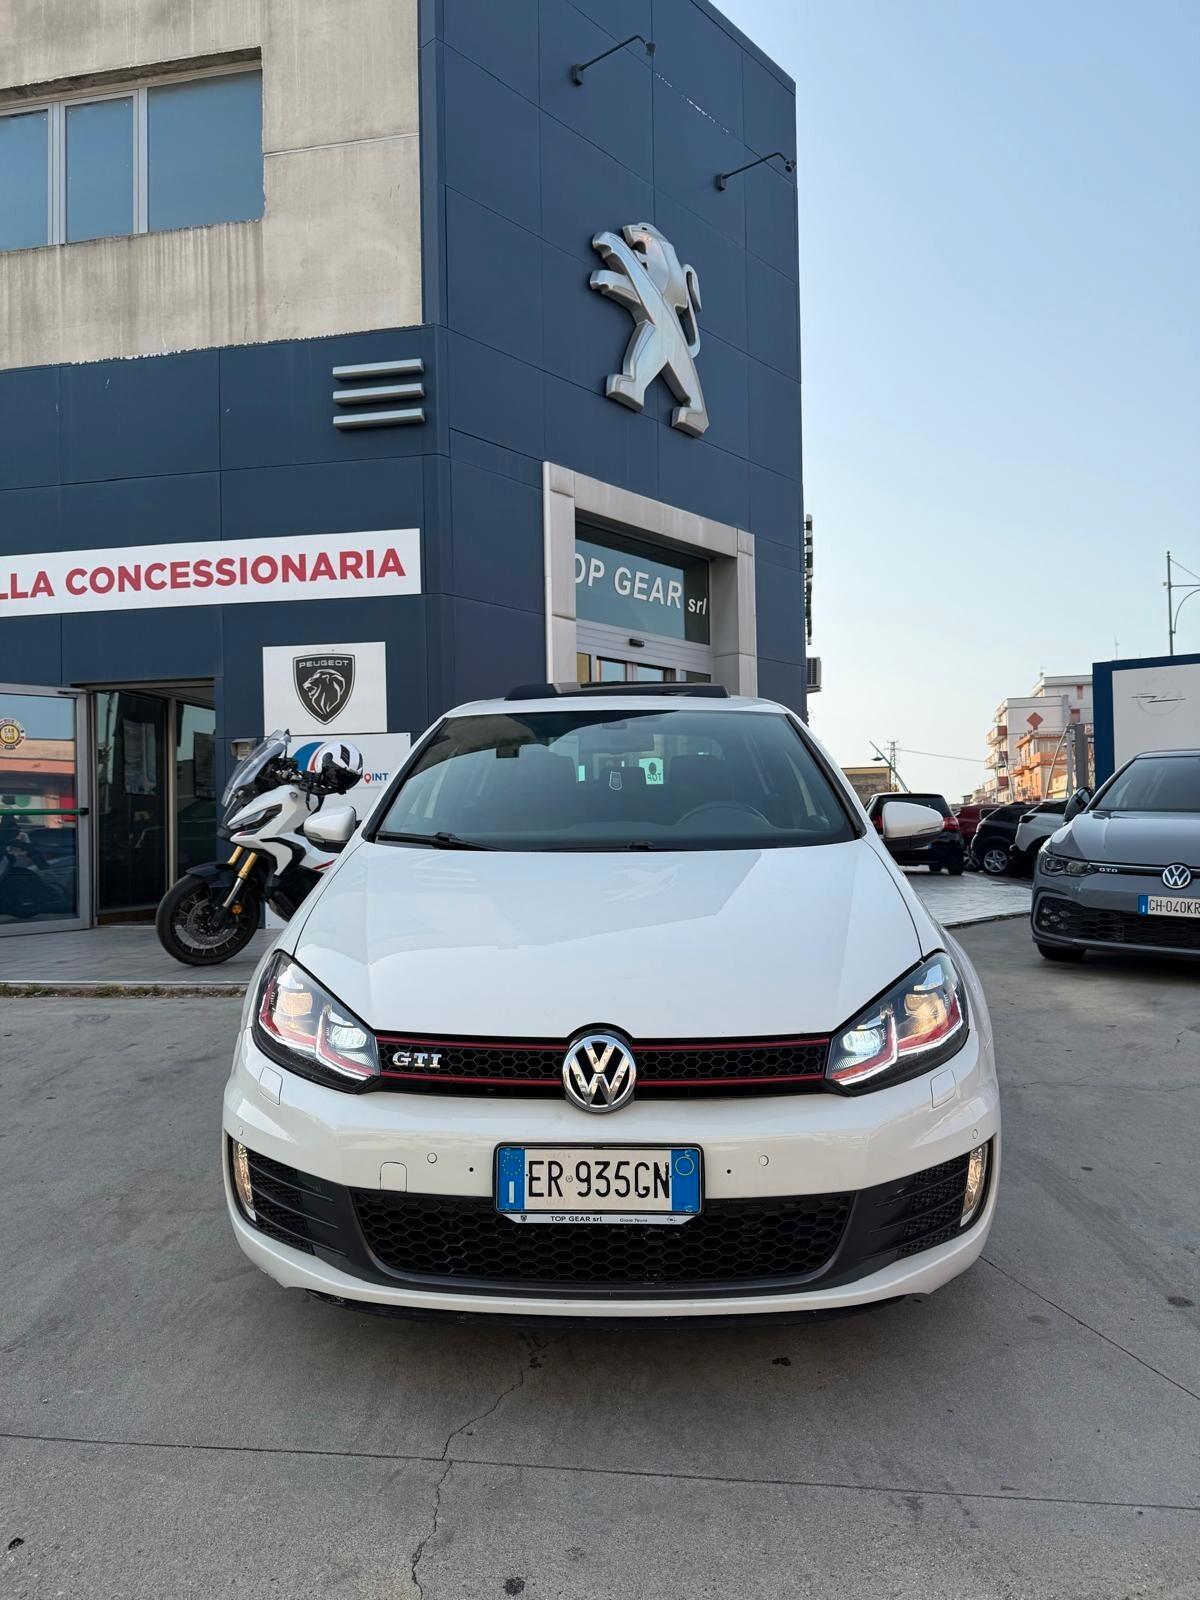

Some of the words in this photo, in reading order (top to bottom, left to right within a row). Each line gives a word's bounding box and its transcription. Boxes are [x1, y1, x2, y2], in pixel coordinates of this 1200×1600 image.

[65, 548, 406, 596] CONCESSIONARIA
[614, 566, 682, 609] GEAR
[688, 597, 707, 615] srl
[299, 660, 349, 668] PEUGEOT
[361, 773, 389, 784] OINT
[393, 1052, 442, 1069] GTI
[529, 1161, 564, 1198] ER
[575, 1161, 670, 1199] 935GN
